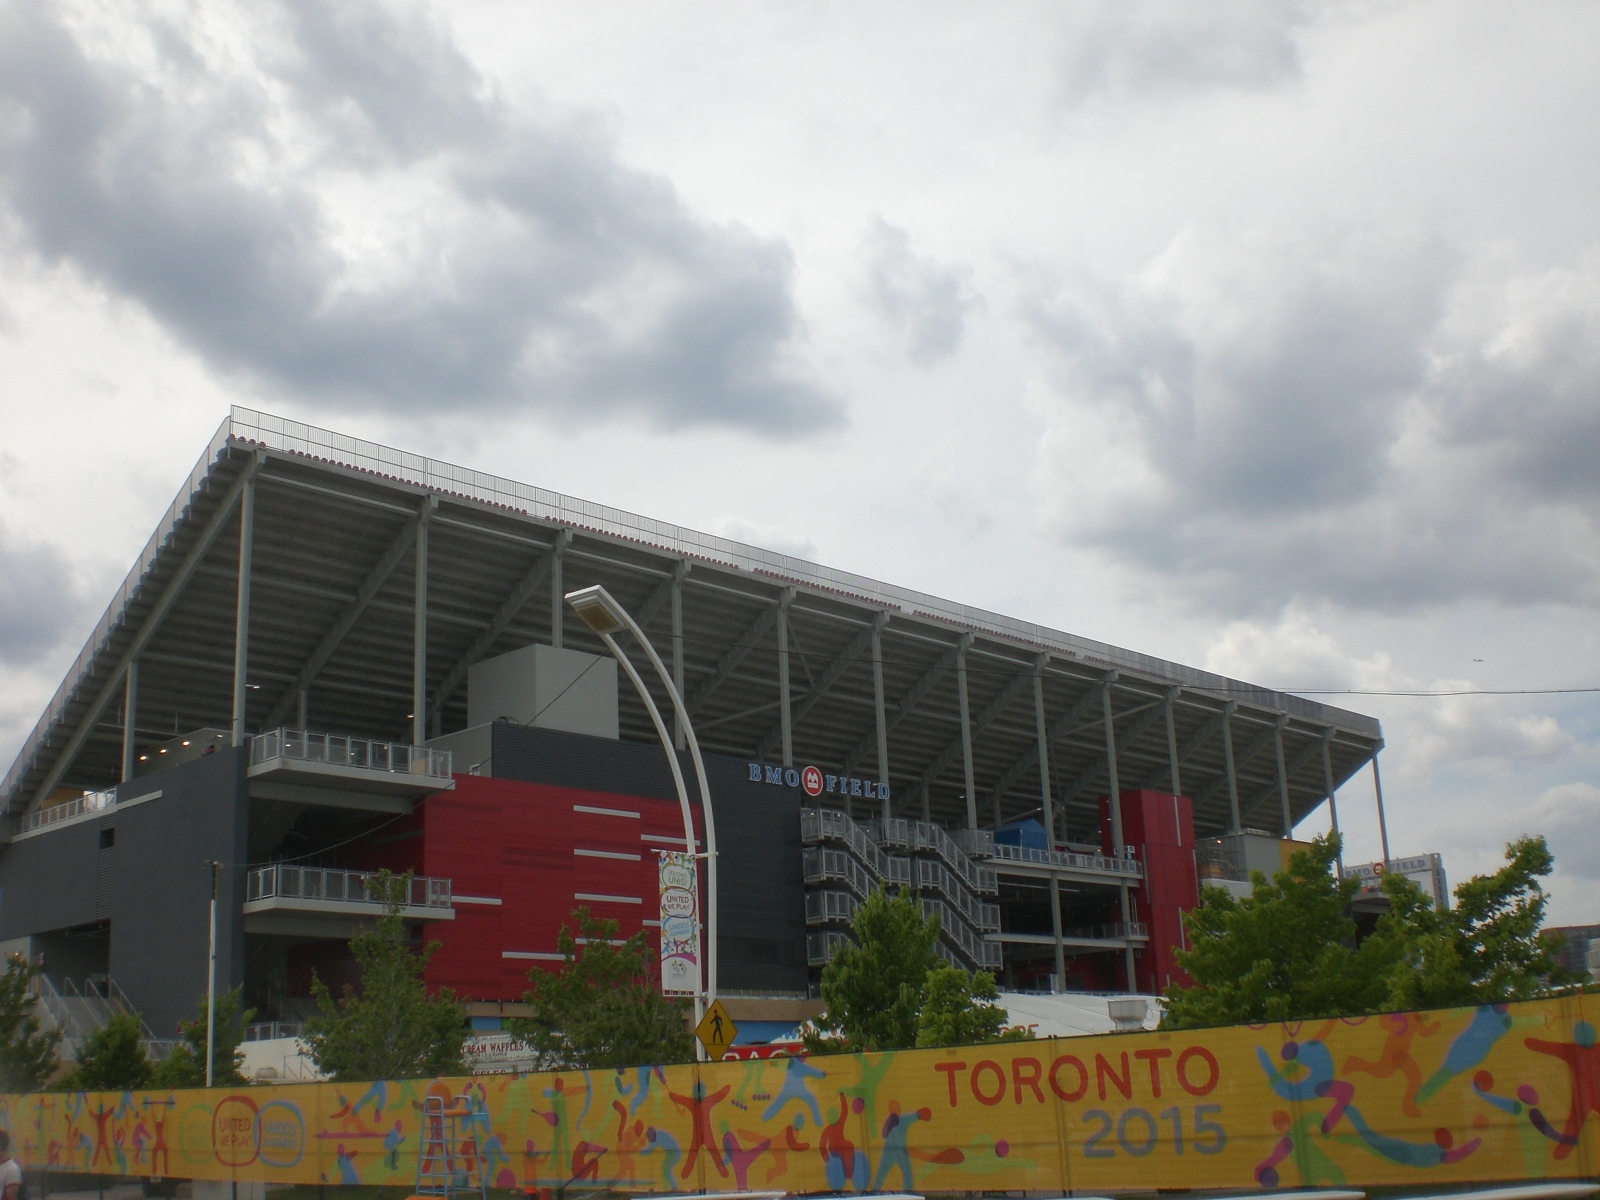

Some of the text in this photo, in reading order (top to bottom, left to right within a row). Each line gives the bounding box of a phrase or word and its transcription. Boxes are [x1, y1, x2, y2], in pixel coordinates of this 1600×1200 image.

[749, 763, 890, 800] BMO FIELD
[666, 895, 690, 904] UNITED
[490, 1042, 524, 1053] WAFFLES
[934, 1046, 1220, 1108] TORONTO
[219, 1117, 251, 1133] UNITED
[1082, 1104, 1227, 1159] 2015
